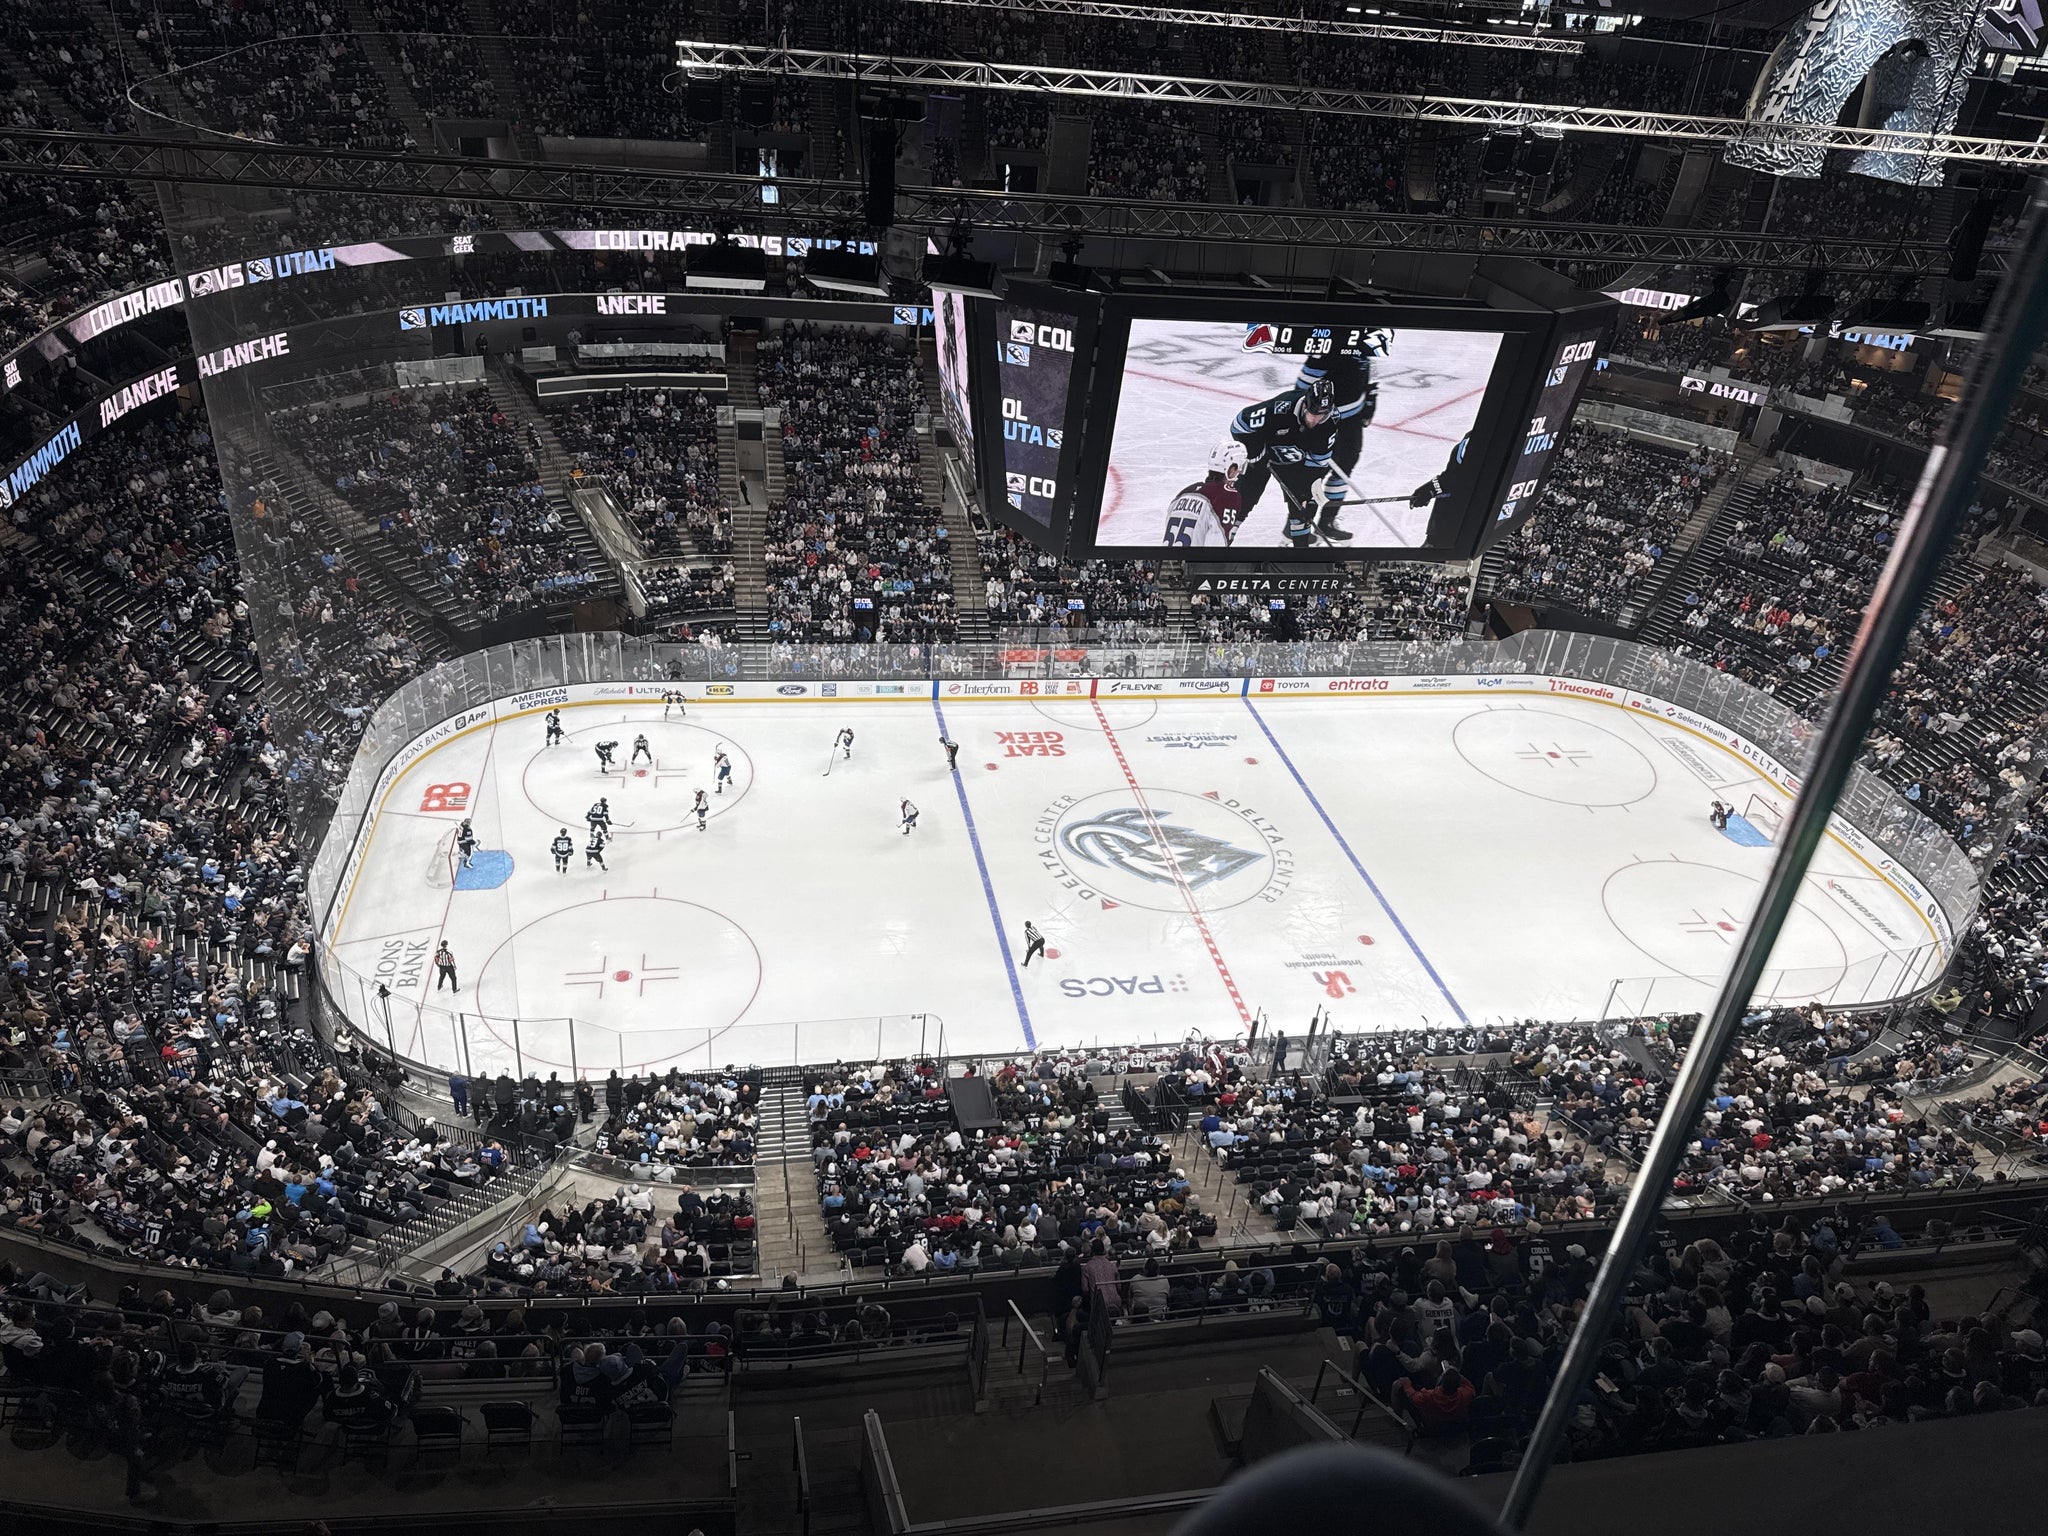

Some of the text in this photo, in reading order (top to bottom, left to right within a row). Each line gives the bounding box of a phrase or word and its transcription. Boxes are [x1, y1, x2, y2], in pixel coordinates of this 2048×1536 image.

[453, 236, 472, 245] SEAT
[453, 244, 474, 254] GEEK
[90, 248, 335, 336] COLORADO VS UTAH
[1621, 289, 1701, 310] COLOR
[430, 298, 547, 326] MAMMOTH
[1038, 325, 1075, 352] COL
[1281, 328, 1360, 346] 0 2ND 2
[1304, 338, 1332, 353] 8:30
[199, 333, 290, 379] ALANCHE
[4, 359, 18, 377] SEAT
[7, 370, 22, 389] GEEK
[1250, 407, 1267, 428] 53
[1004, 420, 1043, 446] UTA
[9, 420, 82, 498] MAMMOTH
[1029, 477, 1056, 499] CO
[1223, 508, 1237, 525] 55
[1164, 517, 1197, 547] 55
[1216, 580, 1339, 590] DELTA CENTER
[708, 686, 731, 694] IKEA
[781, 686, 804, 695] Ford
[964, 683, 1011, 698] Interform
[1120, 683, 1163, 692] FILEVINE
[1328, 678, 1389, 691] entrata
[1557, 680, 1614, 699] Trucordia
[511, 688, 567, 705] AMERICAN
[519, 695, 569, 711] EXPRESS
[1677, 711, 1728, 741] Select Health
[399, 724, 451, 766] ZIONS BANK
[994, 731, 1064, 744] GEEK
[1004, 744, 1067, 757] SEAT
[1743, 744, 1779, 778] DELTA
[592, 805, 603, 815] 50
[557, 843, 568, 851] 98
[1034, 795, 1096, 901] DELTA CENTER
[1224, 798, 1295, 904] DELTA CENTER
[340, 859, 358, 900] DELTA
[1833, 883, 1903, 942] CROWDSTRIKE
[371, 940, 404, 990] ZIONS
[397, 936, 430, 988] BANK
[1060, 974, 1165, 998] PACS
[1427, 1038, 1436, 1050] 16
[1133, 1058, 1142, 1067] 57
[146, 1228, 160, 1245] 10
[1531, 1247, 1550, 1255] COOLEY
[575, 1386, 590, 1396] BUT
